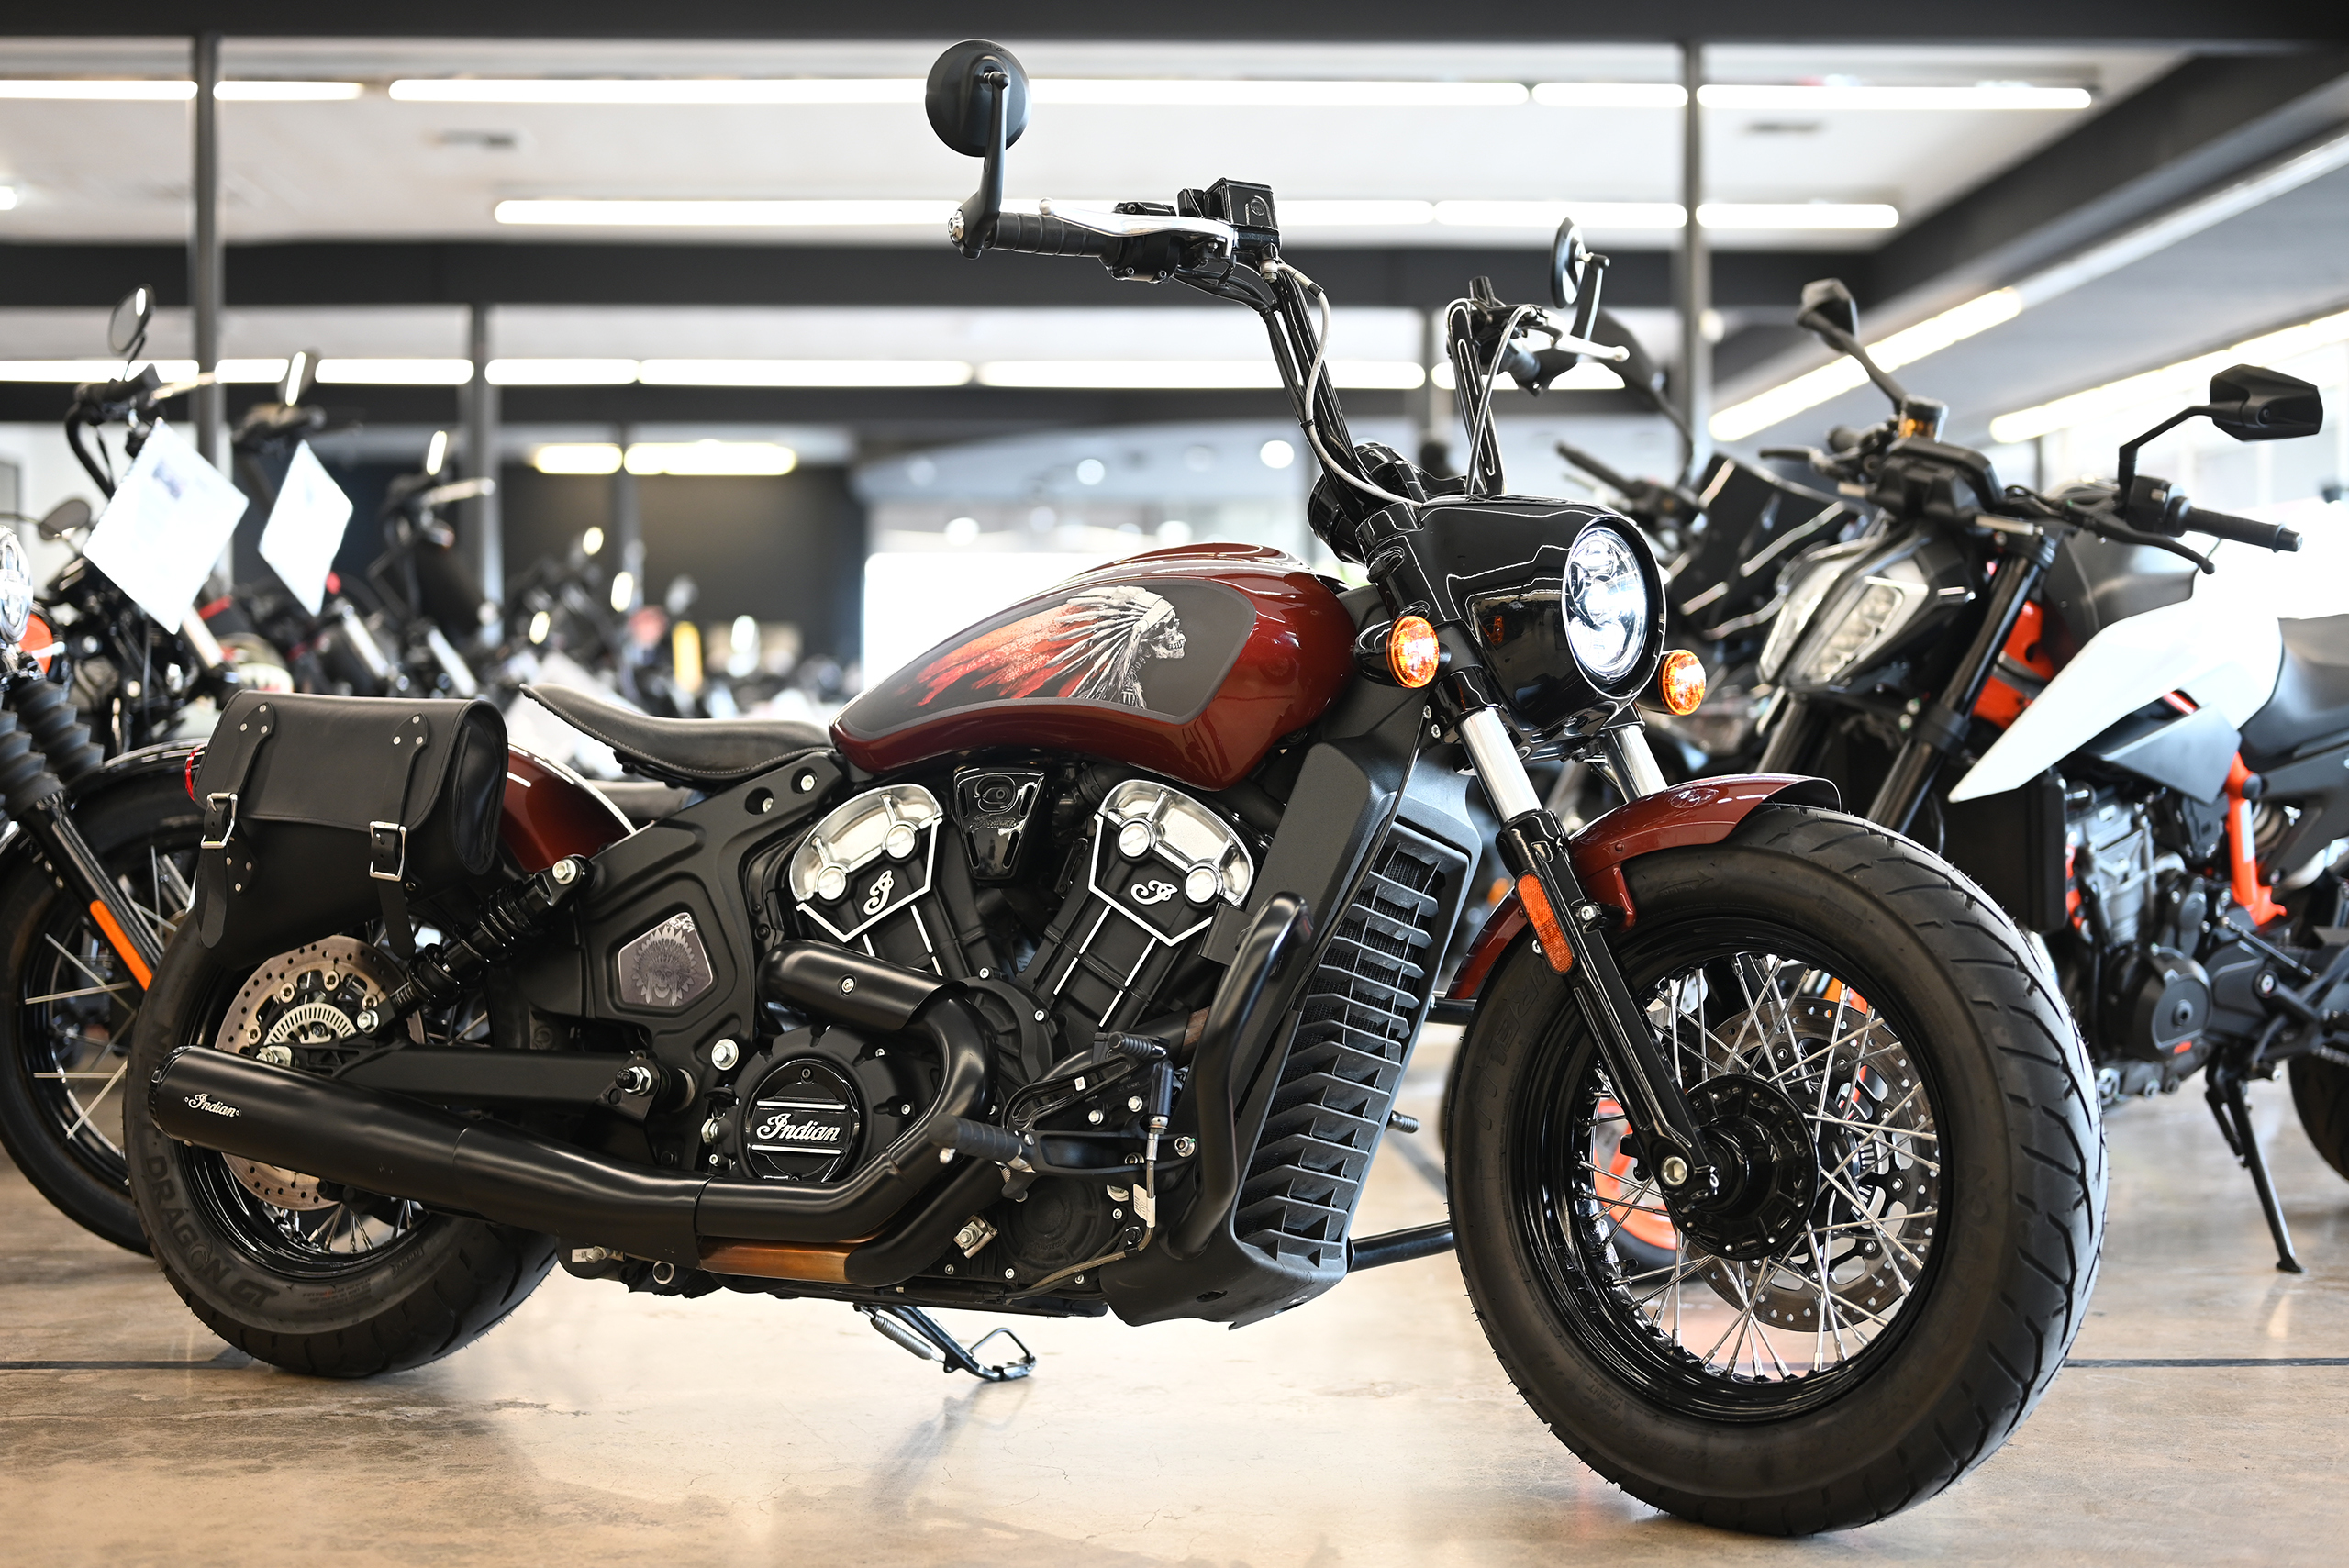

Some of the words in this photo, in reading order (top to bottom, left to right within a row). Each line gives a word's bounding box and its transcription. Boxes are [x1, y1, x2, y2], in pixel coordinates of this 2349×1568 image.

[187, 1093, 236, 1118] Indian
[756, 1112, 841, 1142] Indian
[146, 1155, 232, 1285] DRAGON
[1586, 1384, 1620, 1411] FRONT
